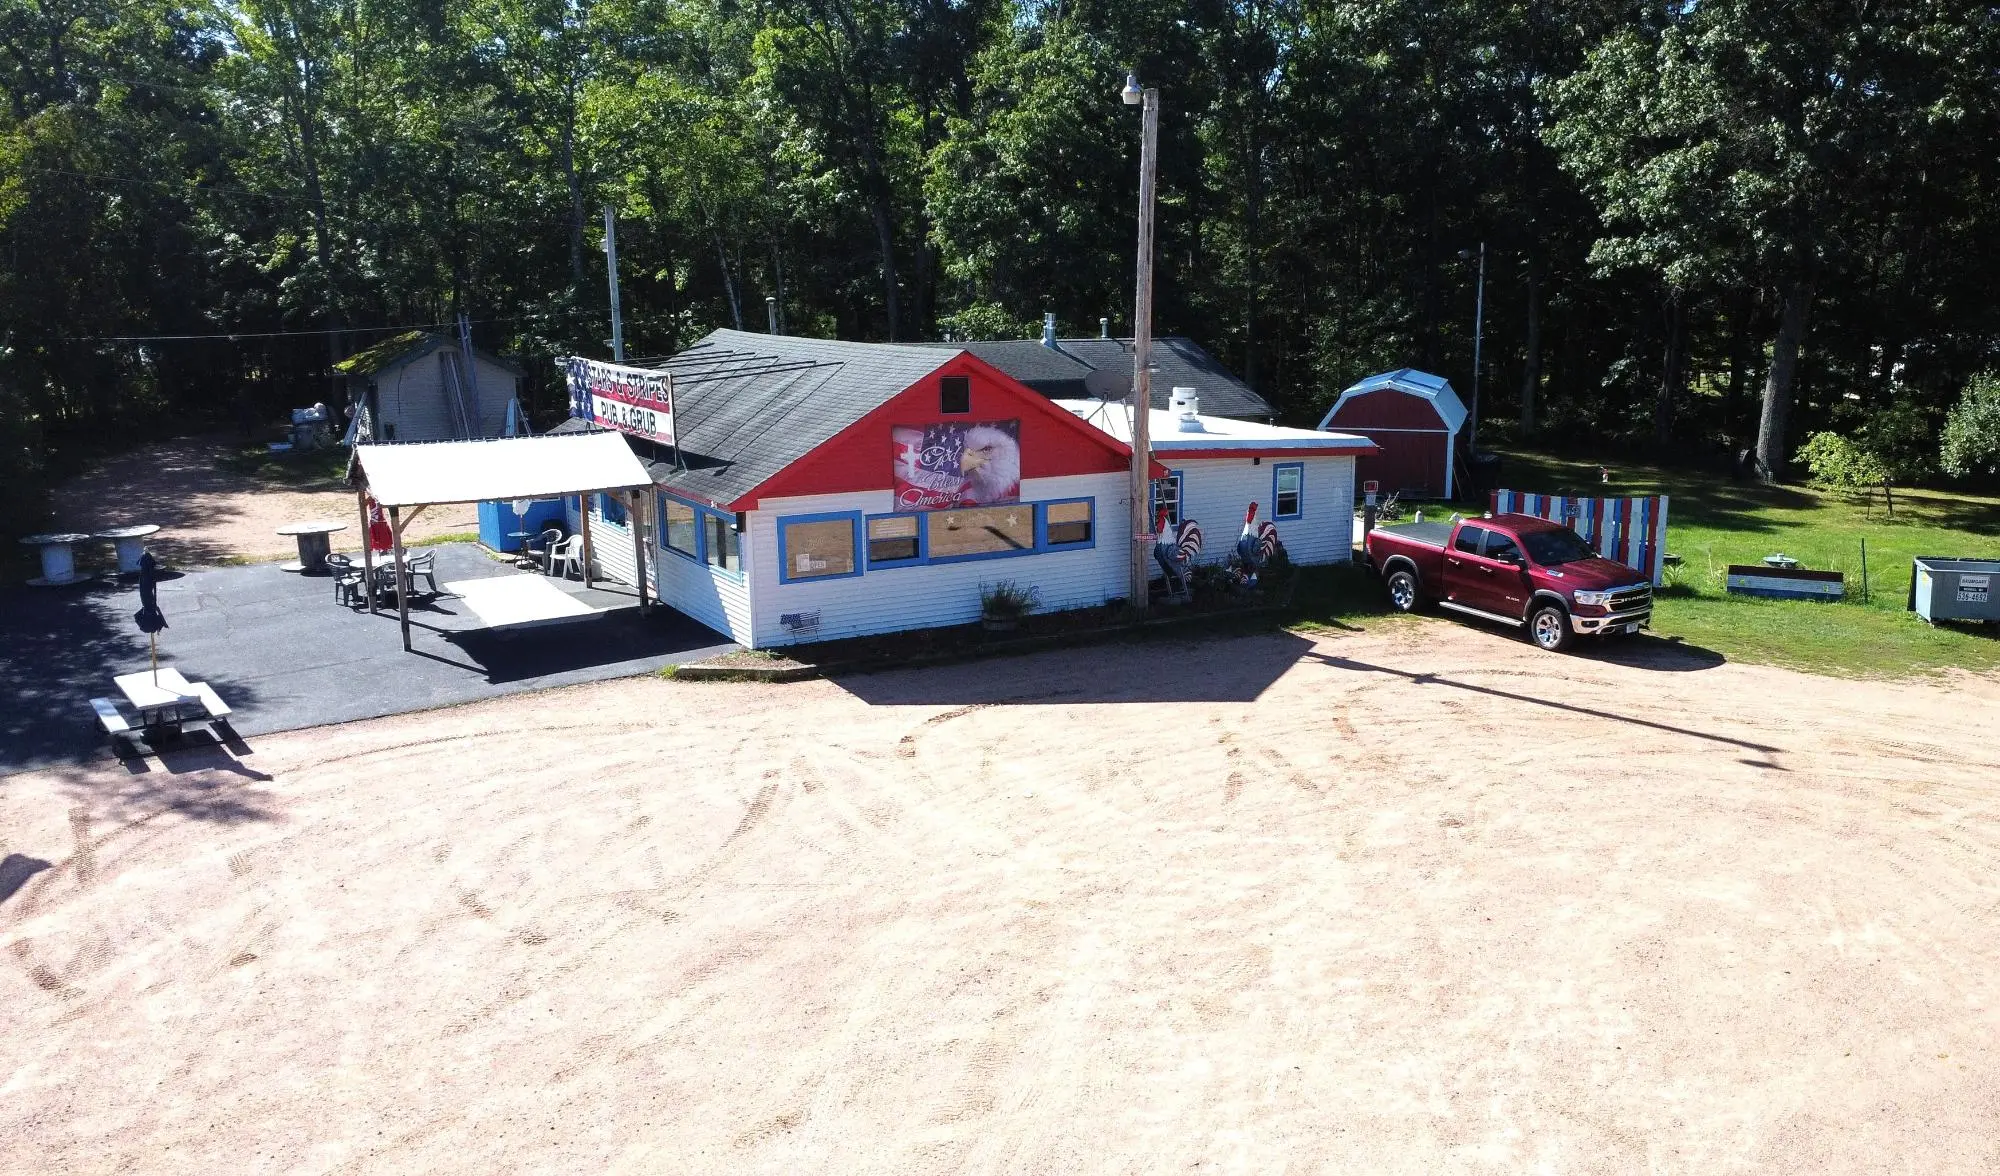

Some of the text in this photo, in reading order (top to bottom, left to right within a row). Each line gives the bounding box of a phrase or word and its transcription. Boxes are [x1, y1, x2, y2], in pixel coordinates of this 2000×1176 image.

[587, 365, 669, 403] STARS & STRIPES
[601, 401, 657, 436] PUB & GRUB
[920, 446, 961, 470] God
[922, 471, 960, 491] Bless
[900, 488, 961, 507] America
